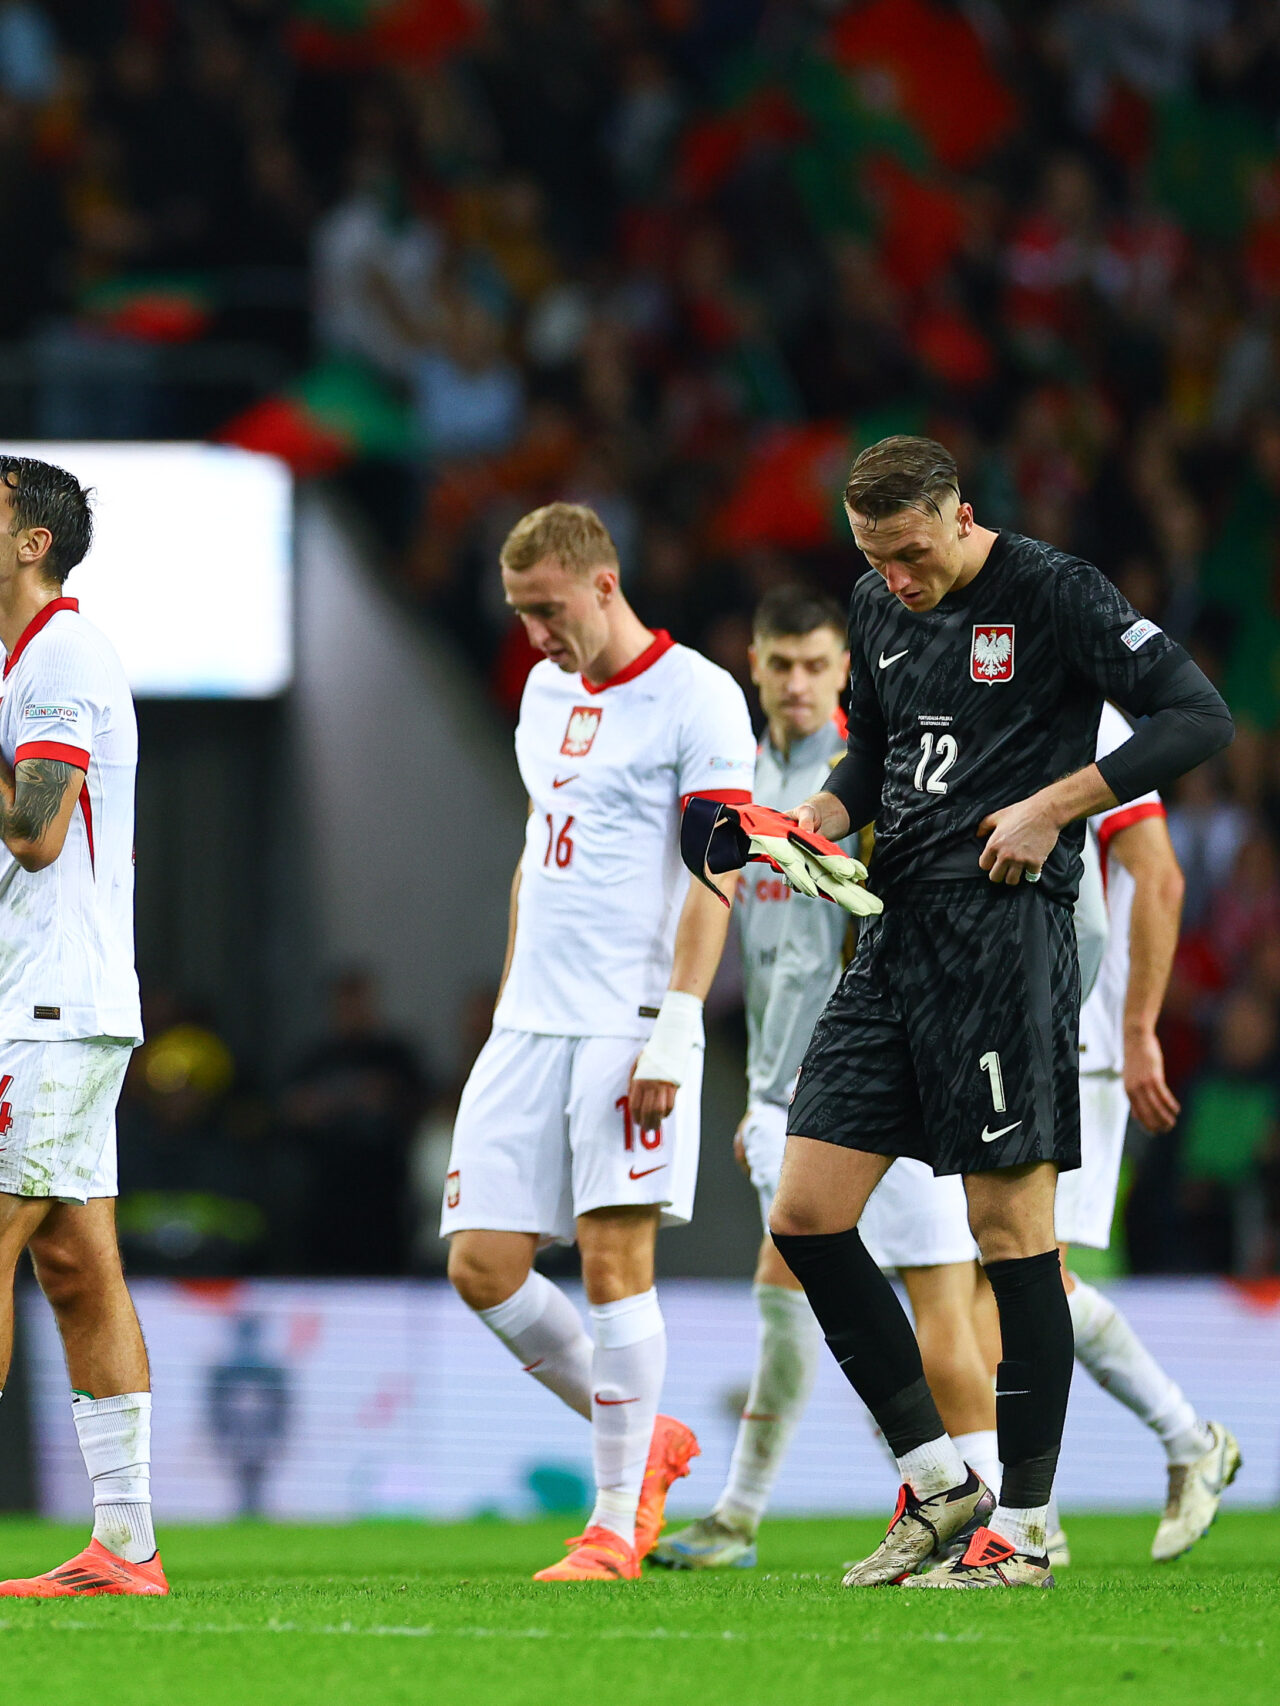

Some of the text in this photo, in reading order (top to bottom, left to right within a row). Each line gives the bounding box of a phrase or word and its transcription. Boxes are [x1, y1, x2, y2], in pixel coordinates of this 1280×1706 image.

[25, 708, 78, 717] FOUNDATION
[914, 732, 958, 794] 12
[544, 813, 575, 869] 16
[979, 1051, 1007, 1113] 1
